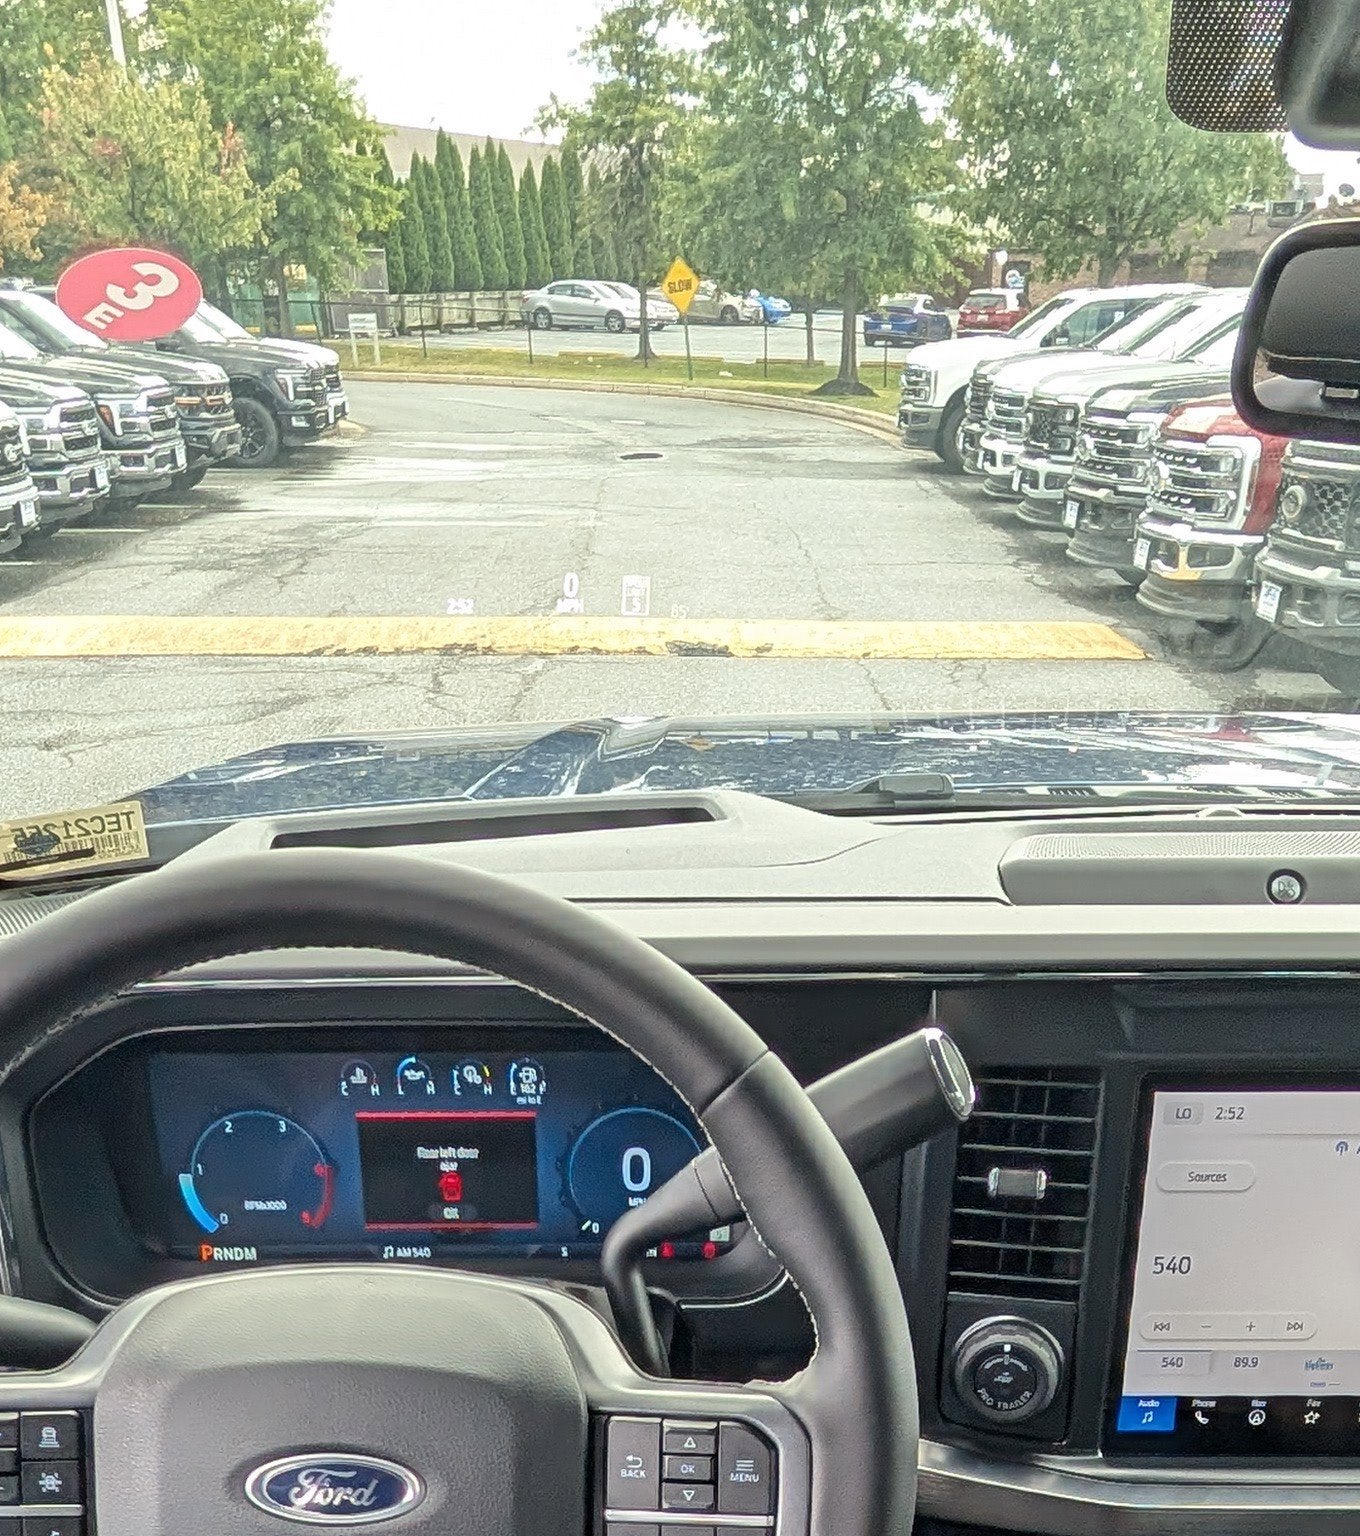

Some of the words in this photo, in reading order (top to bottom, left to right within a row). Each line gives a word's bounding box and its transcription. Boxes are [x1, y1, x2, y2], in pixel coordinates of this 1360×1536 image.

[106, 262, 179, 310] 3
[1215, 1106, 1245, 1120] 2:52
[224, 1120, 233, 1133] 2
[278, 1120, 287, 1133] 3
[621, 1146, 651, 1192] 0
[1188, 1171, 1227, 1184] Sources
[1152, 1255, 1192, 1275] 540
[1161, 1357, 1183, 1368] 540
[1233, 1357, 1258, 1368] 89.9
[620, 1469, 646, 1479] BACK
[681, 1464, 695, 1474] OK
[730, 1473, 759, 1483] MENU
[289, 1467, 379, 1510] Ford
